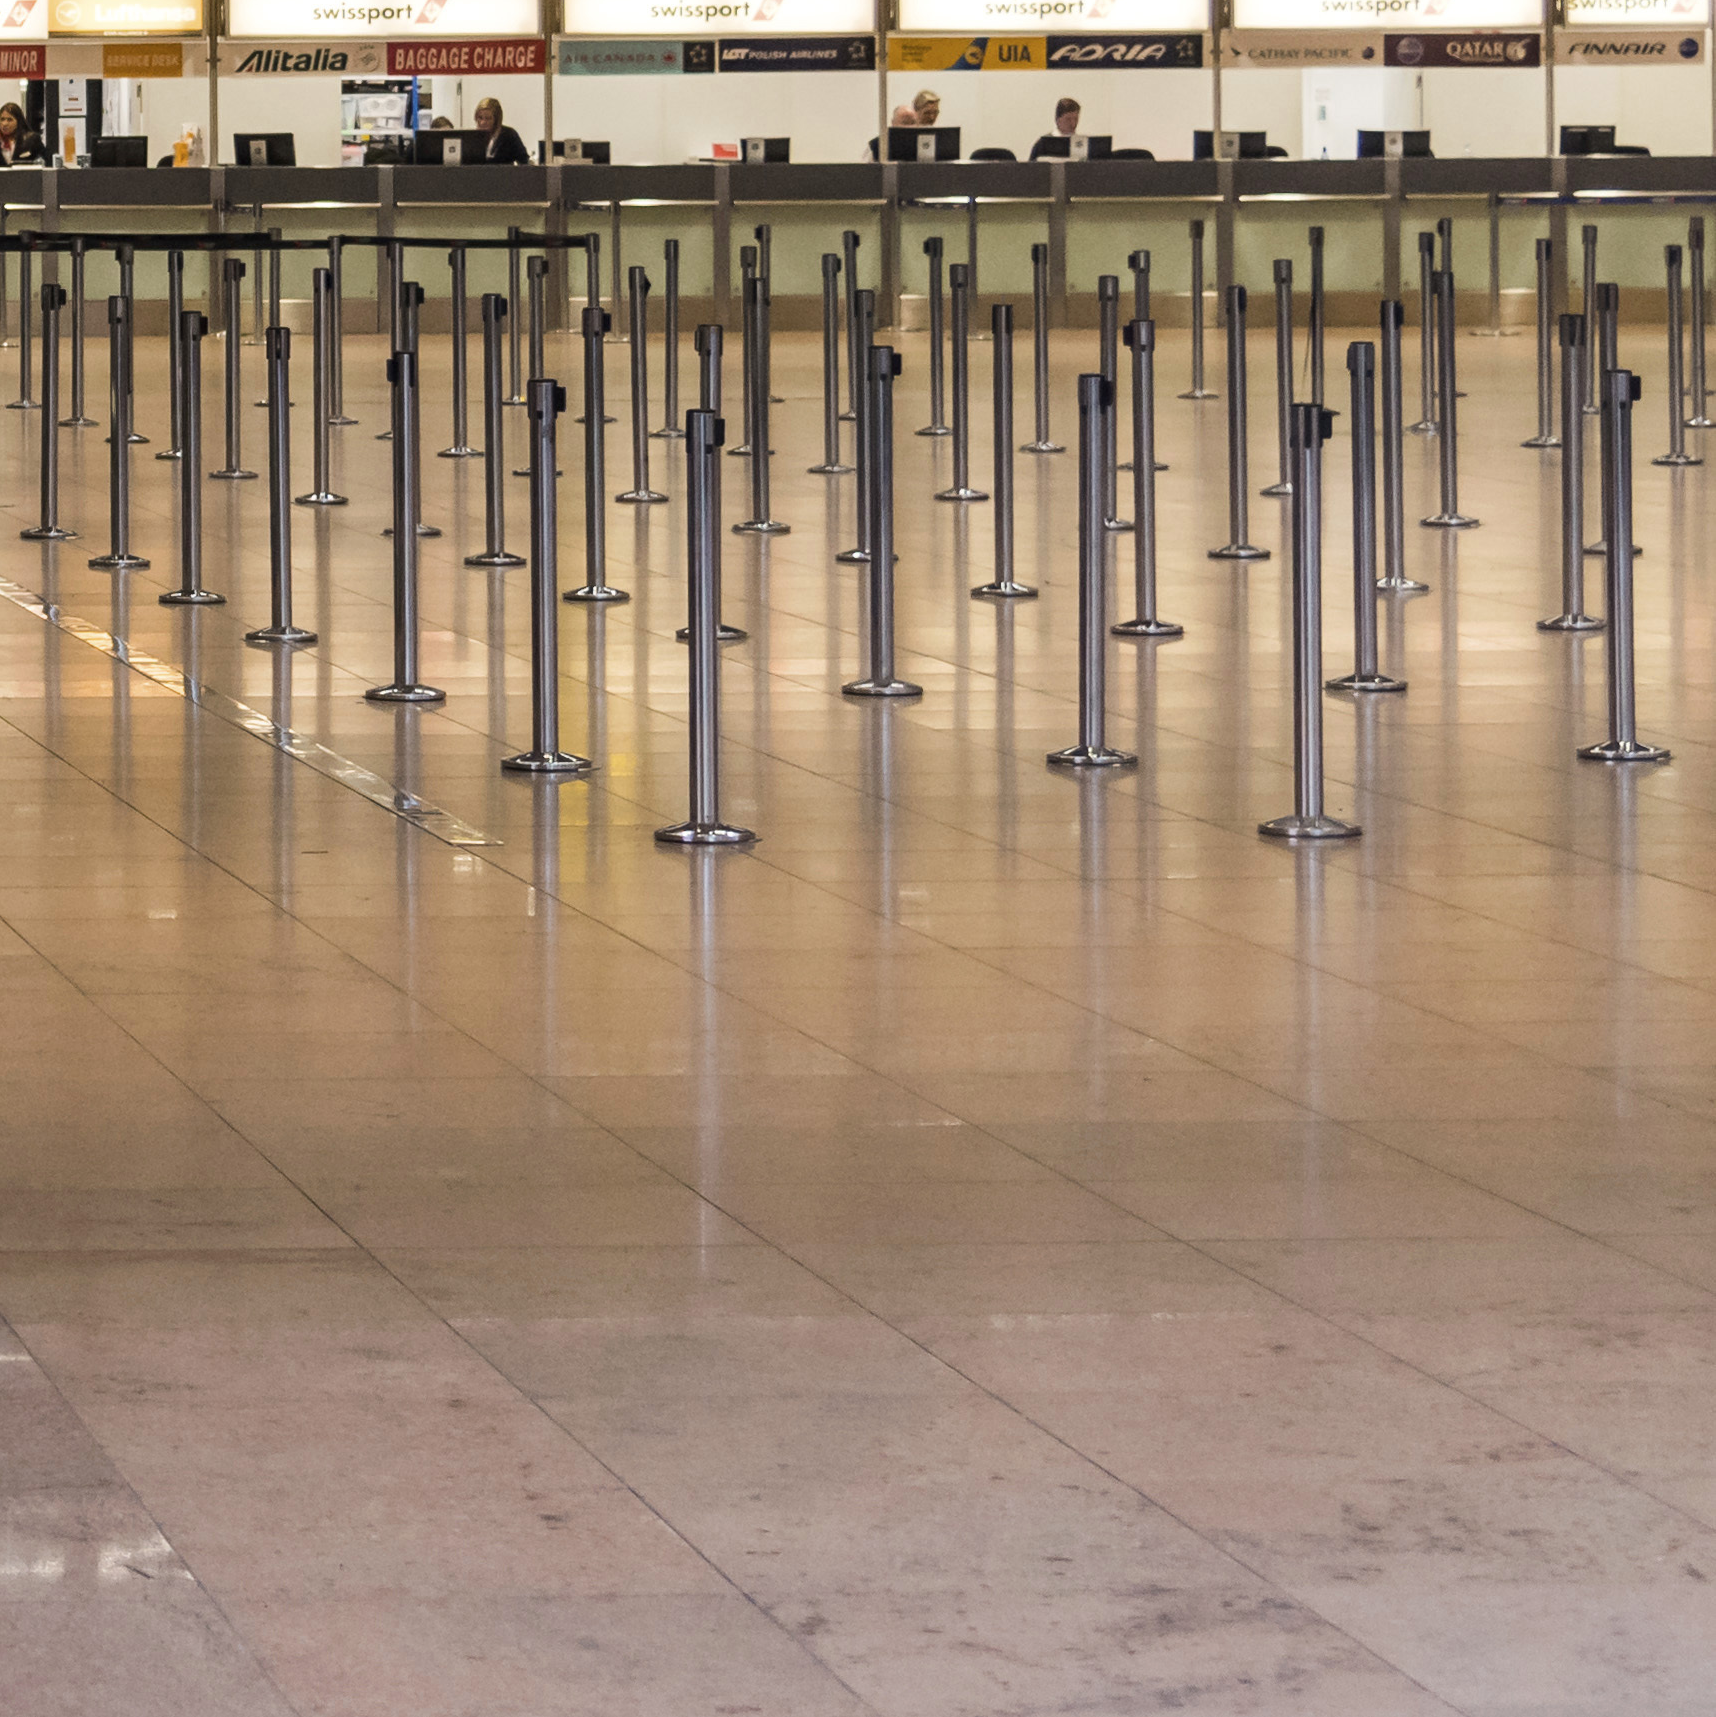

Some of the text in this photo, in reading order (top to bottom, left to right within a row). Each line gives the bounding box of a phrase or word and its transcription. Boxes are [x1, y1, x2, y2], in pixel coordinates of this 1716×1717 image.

[313, 2, 413, 24] swissport
[650, 0, 750, 22] swissport
[394, 45, 536, 71] BAGGAGE CHARGE
[749, 49, 787, 60] POLISH
[789, 49, 838, 59] AIRLINES
[998, 45, 1032, 63] UIA
[1049, 43, 1167, 62] ADRIA
[1248, 48, 1300, 59] CATHAY
[1446, 41, 1504, 60] QATAR
[1568, 42, 1667, 55] FINNAIR
[0, 50, 38, 73] MINOR
[235, 48, 348, 73] Alitalia
